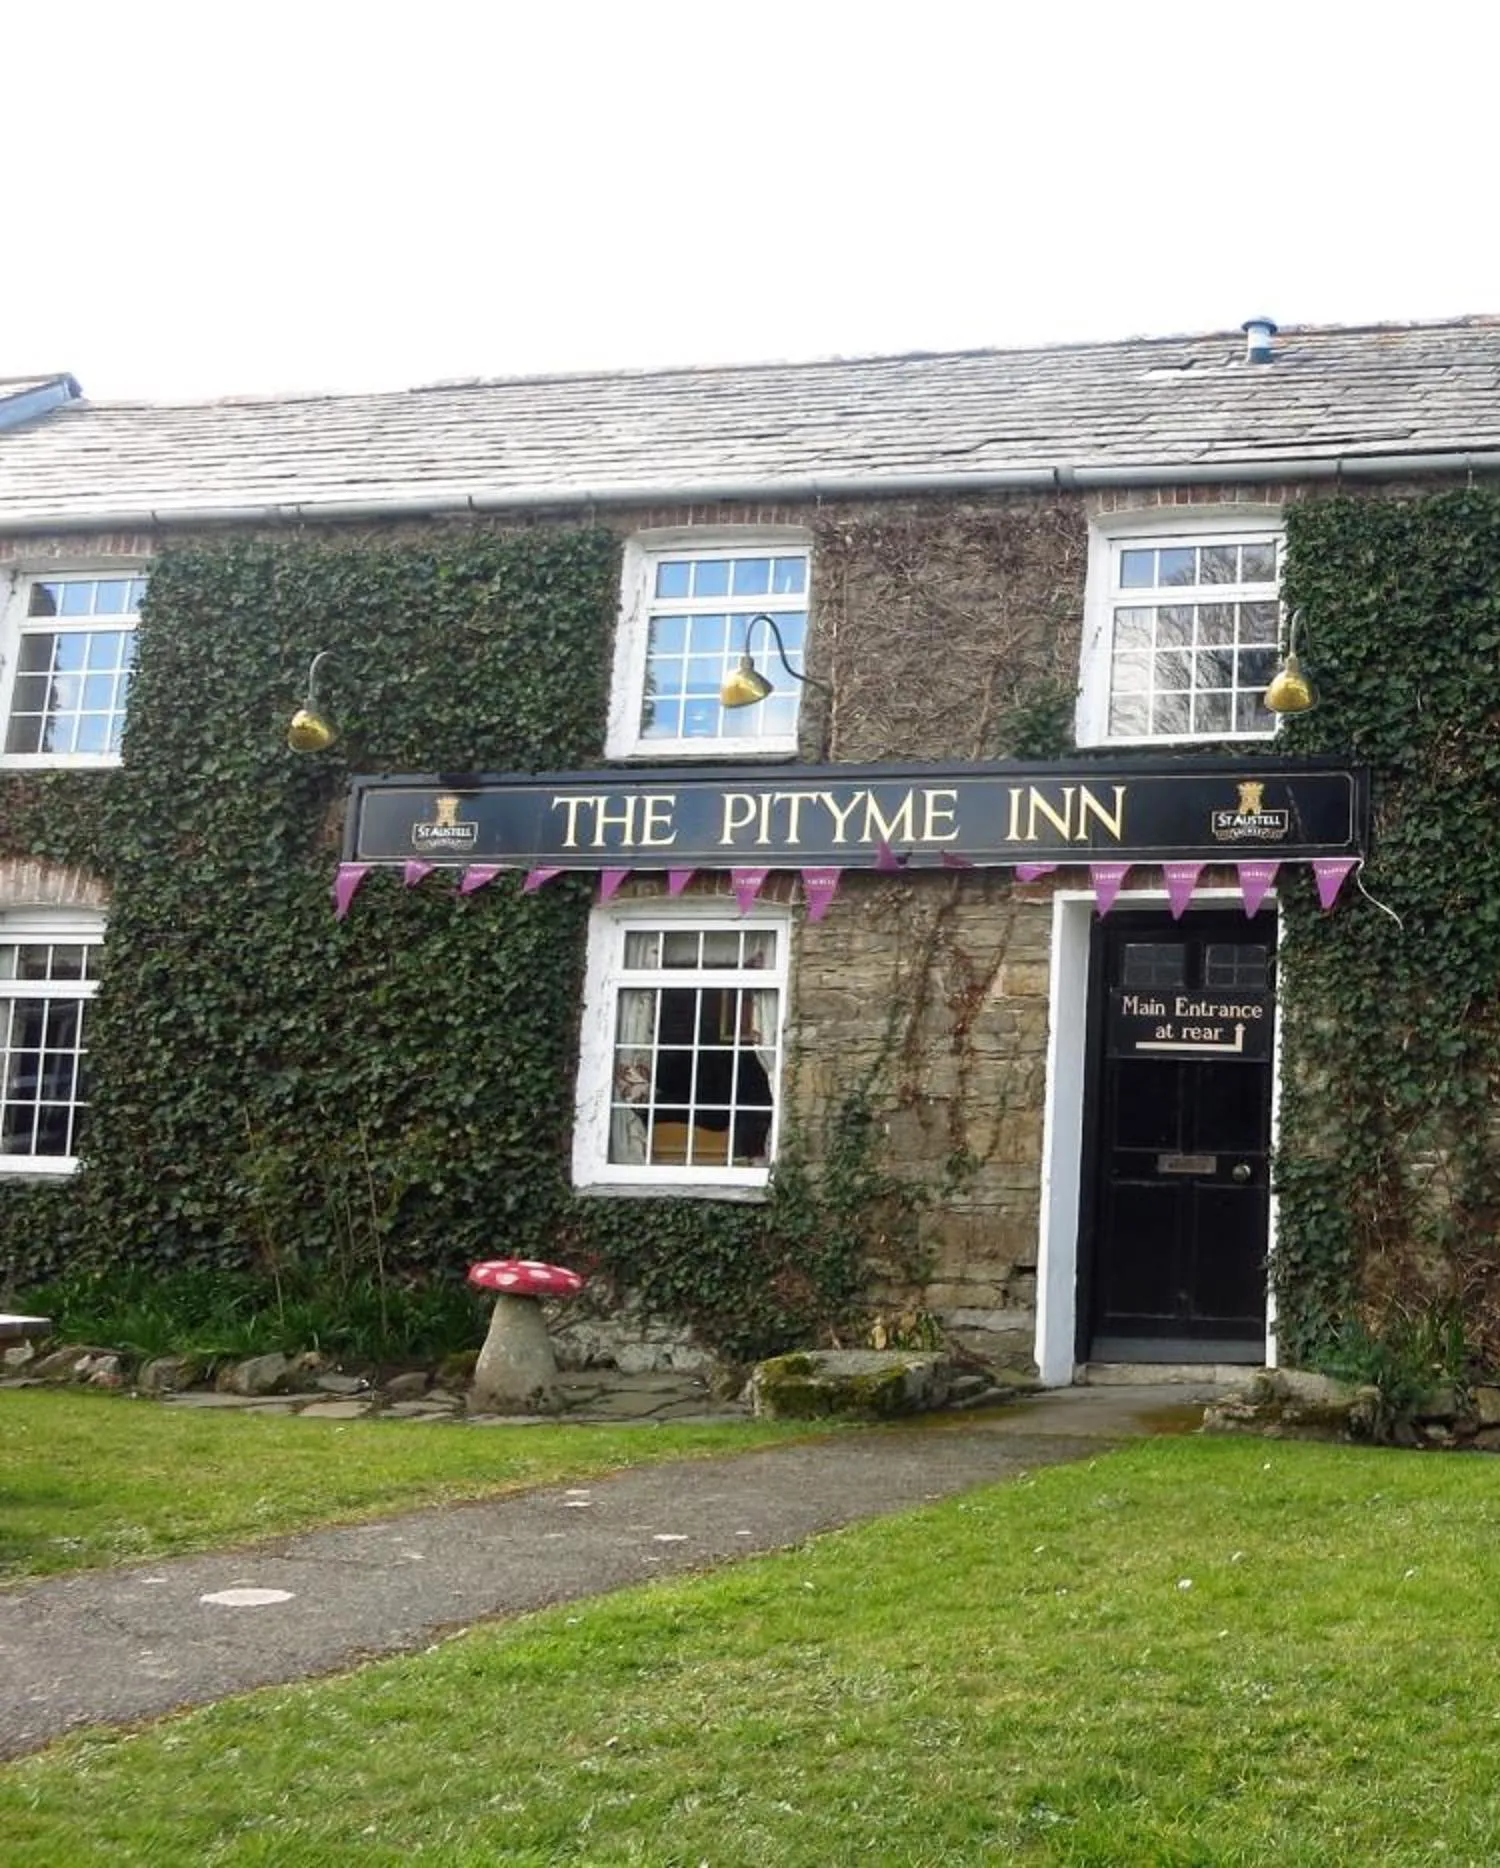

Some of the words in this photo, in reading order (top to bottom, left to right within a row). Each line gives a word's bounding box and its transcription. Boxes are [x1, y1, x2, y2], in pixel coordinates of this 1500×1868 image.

[551, 793, 679, 848] THE
[717, 787, 962, 846] PITYME
[1003, 784, 1127, 841] INN
[1232, 815, 1281, 826] AUSTELL
[1122, 995, 1166, 1016] Main
[1175, 997, 1263, 1018] Entrance
[1155, 1023, 1174, 1039] at
[1181, 1025, 1224, 1040] rear
